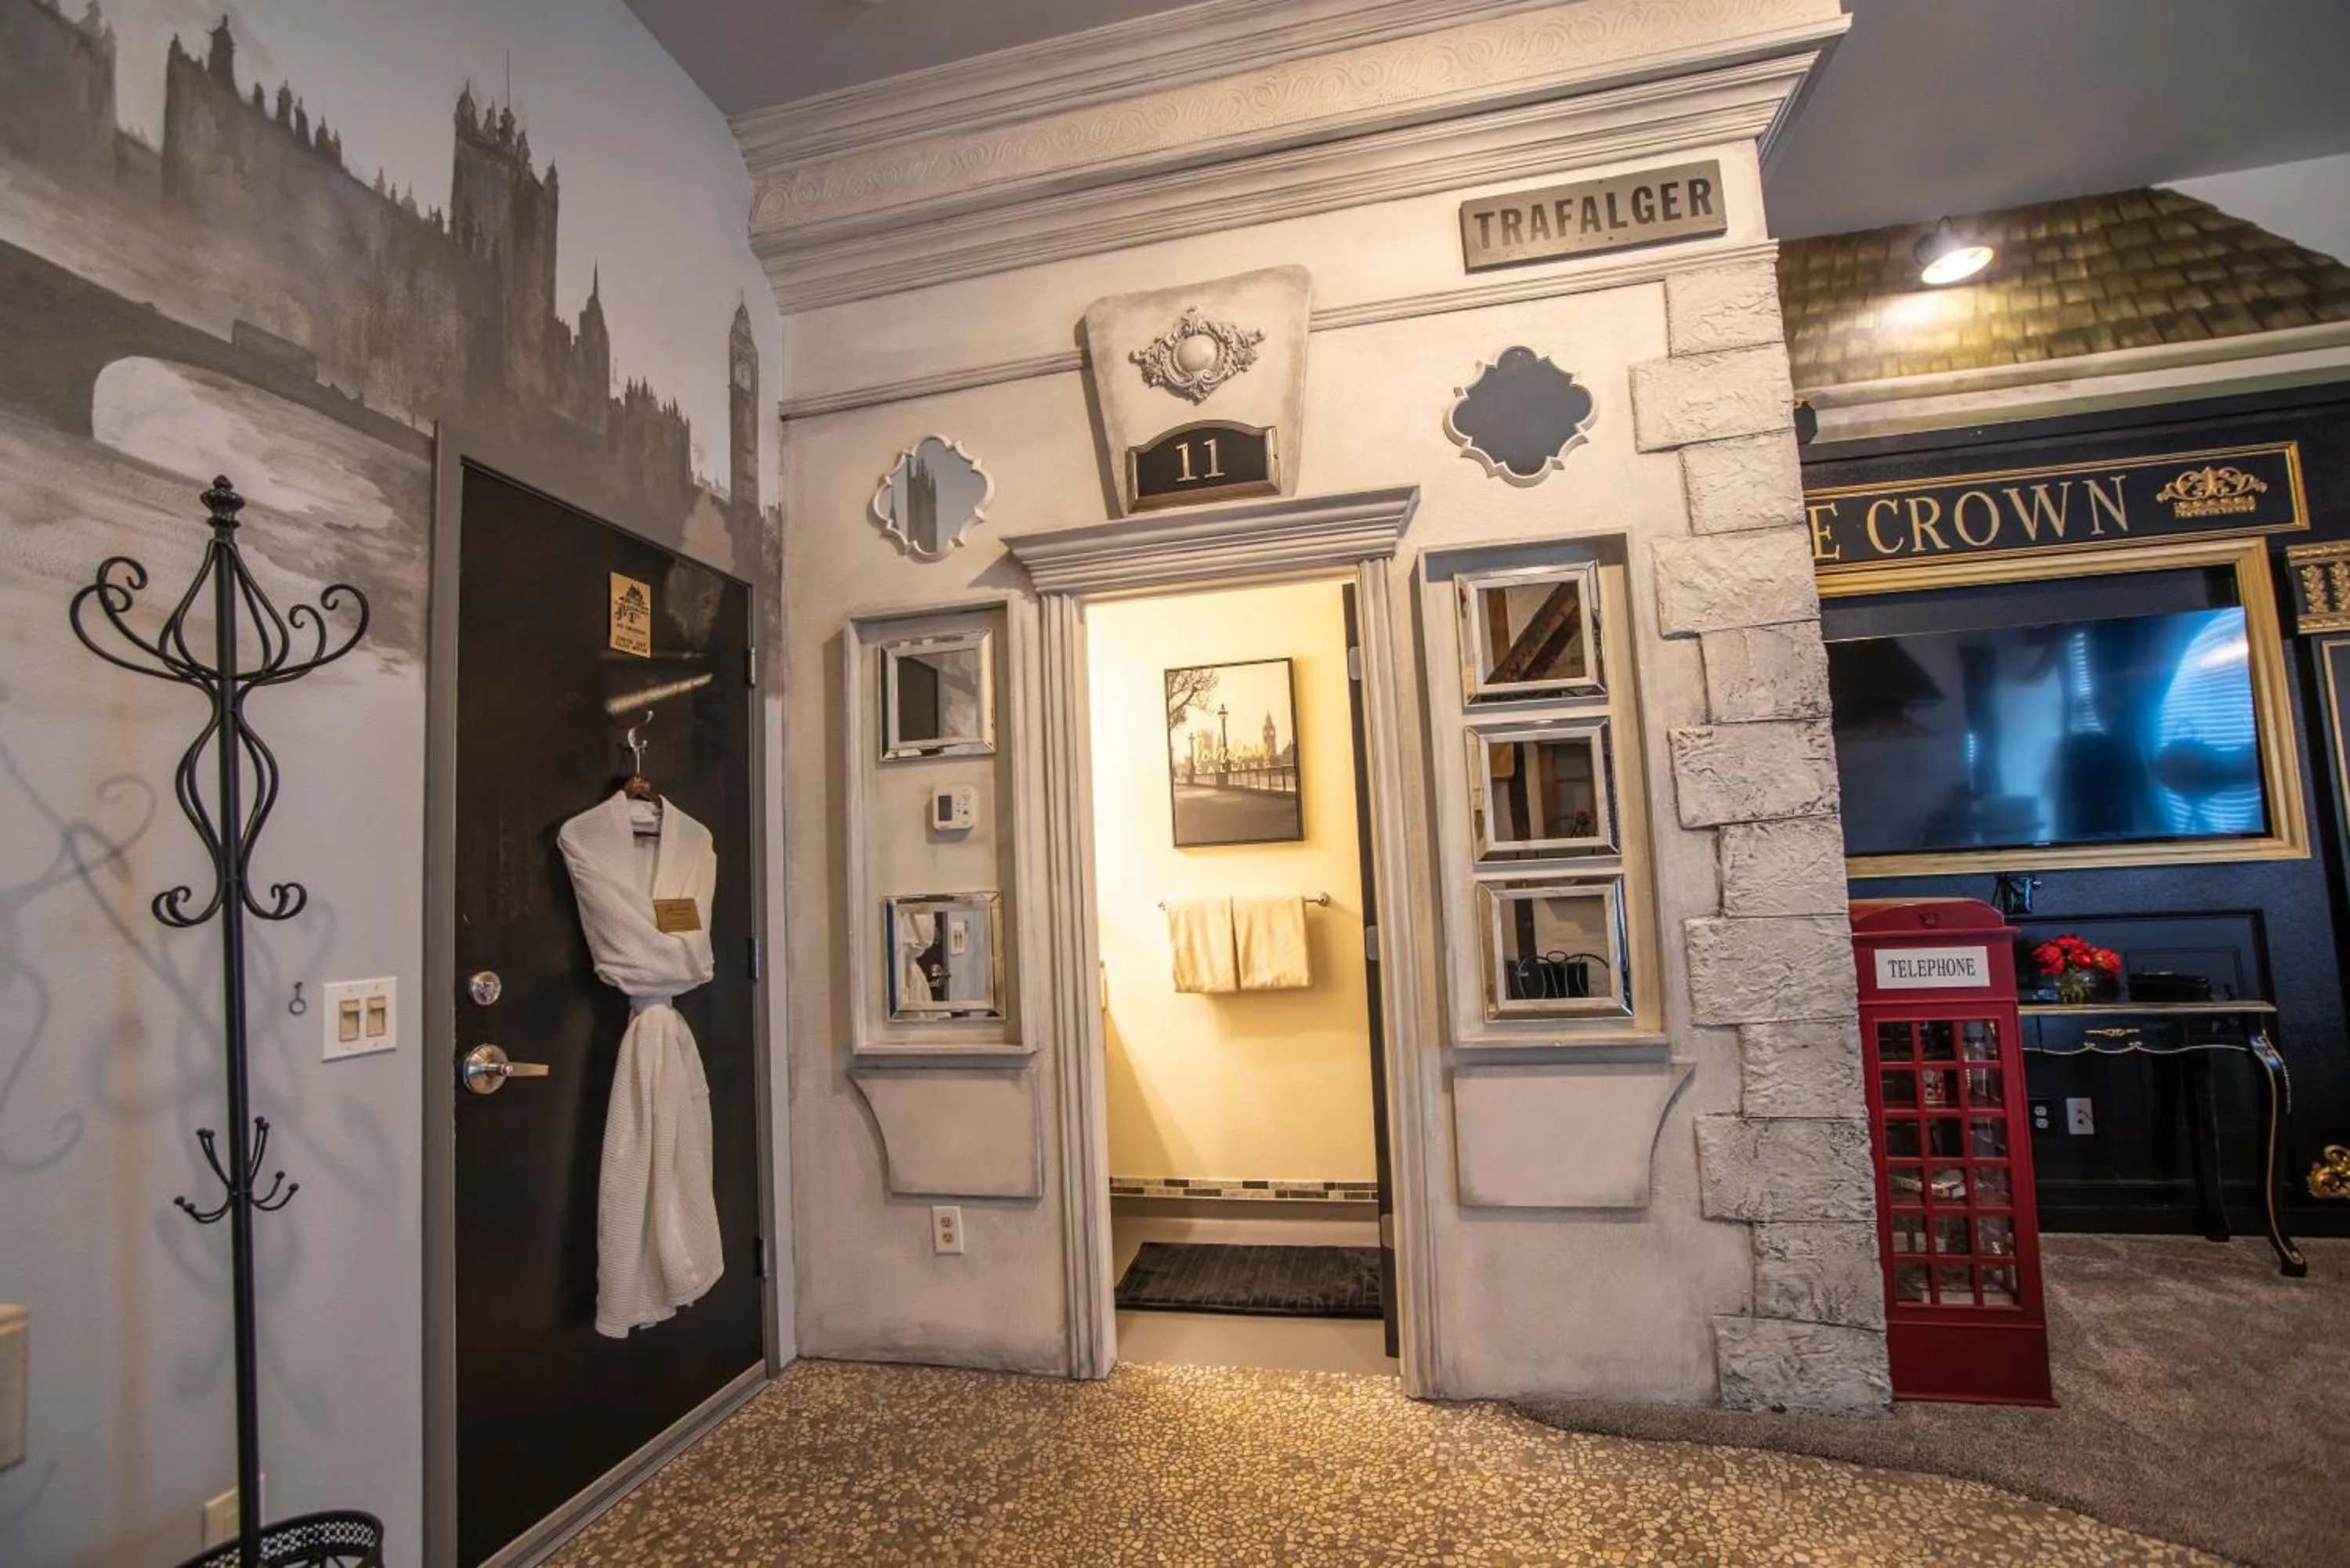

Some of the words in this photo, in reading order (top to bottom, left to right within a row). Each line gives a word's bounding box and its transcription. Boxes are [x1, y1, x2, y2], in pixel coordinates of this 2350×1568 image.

[1473, 177, 1713, 250] TRAFALGER
[1175, 437, 1226, 482] 11
[1866, 475, 2129, 555] CROWN
[1887, 958, 1976, 978] TELEPHONE
